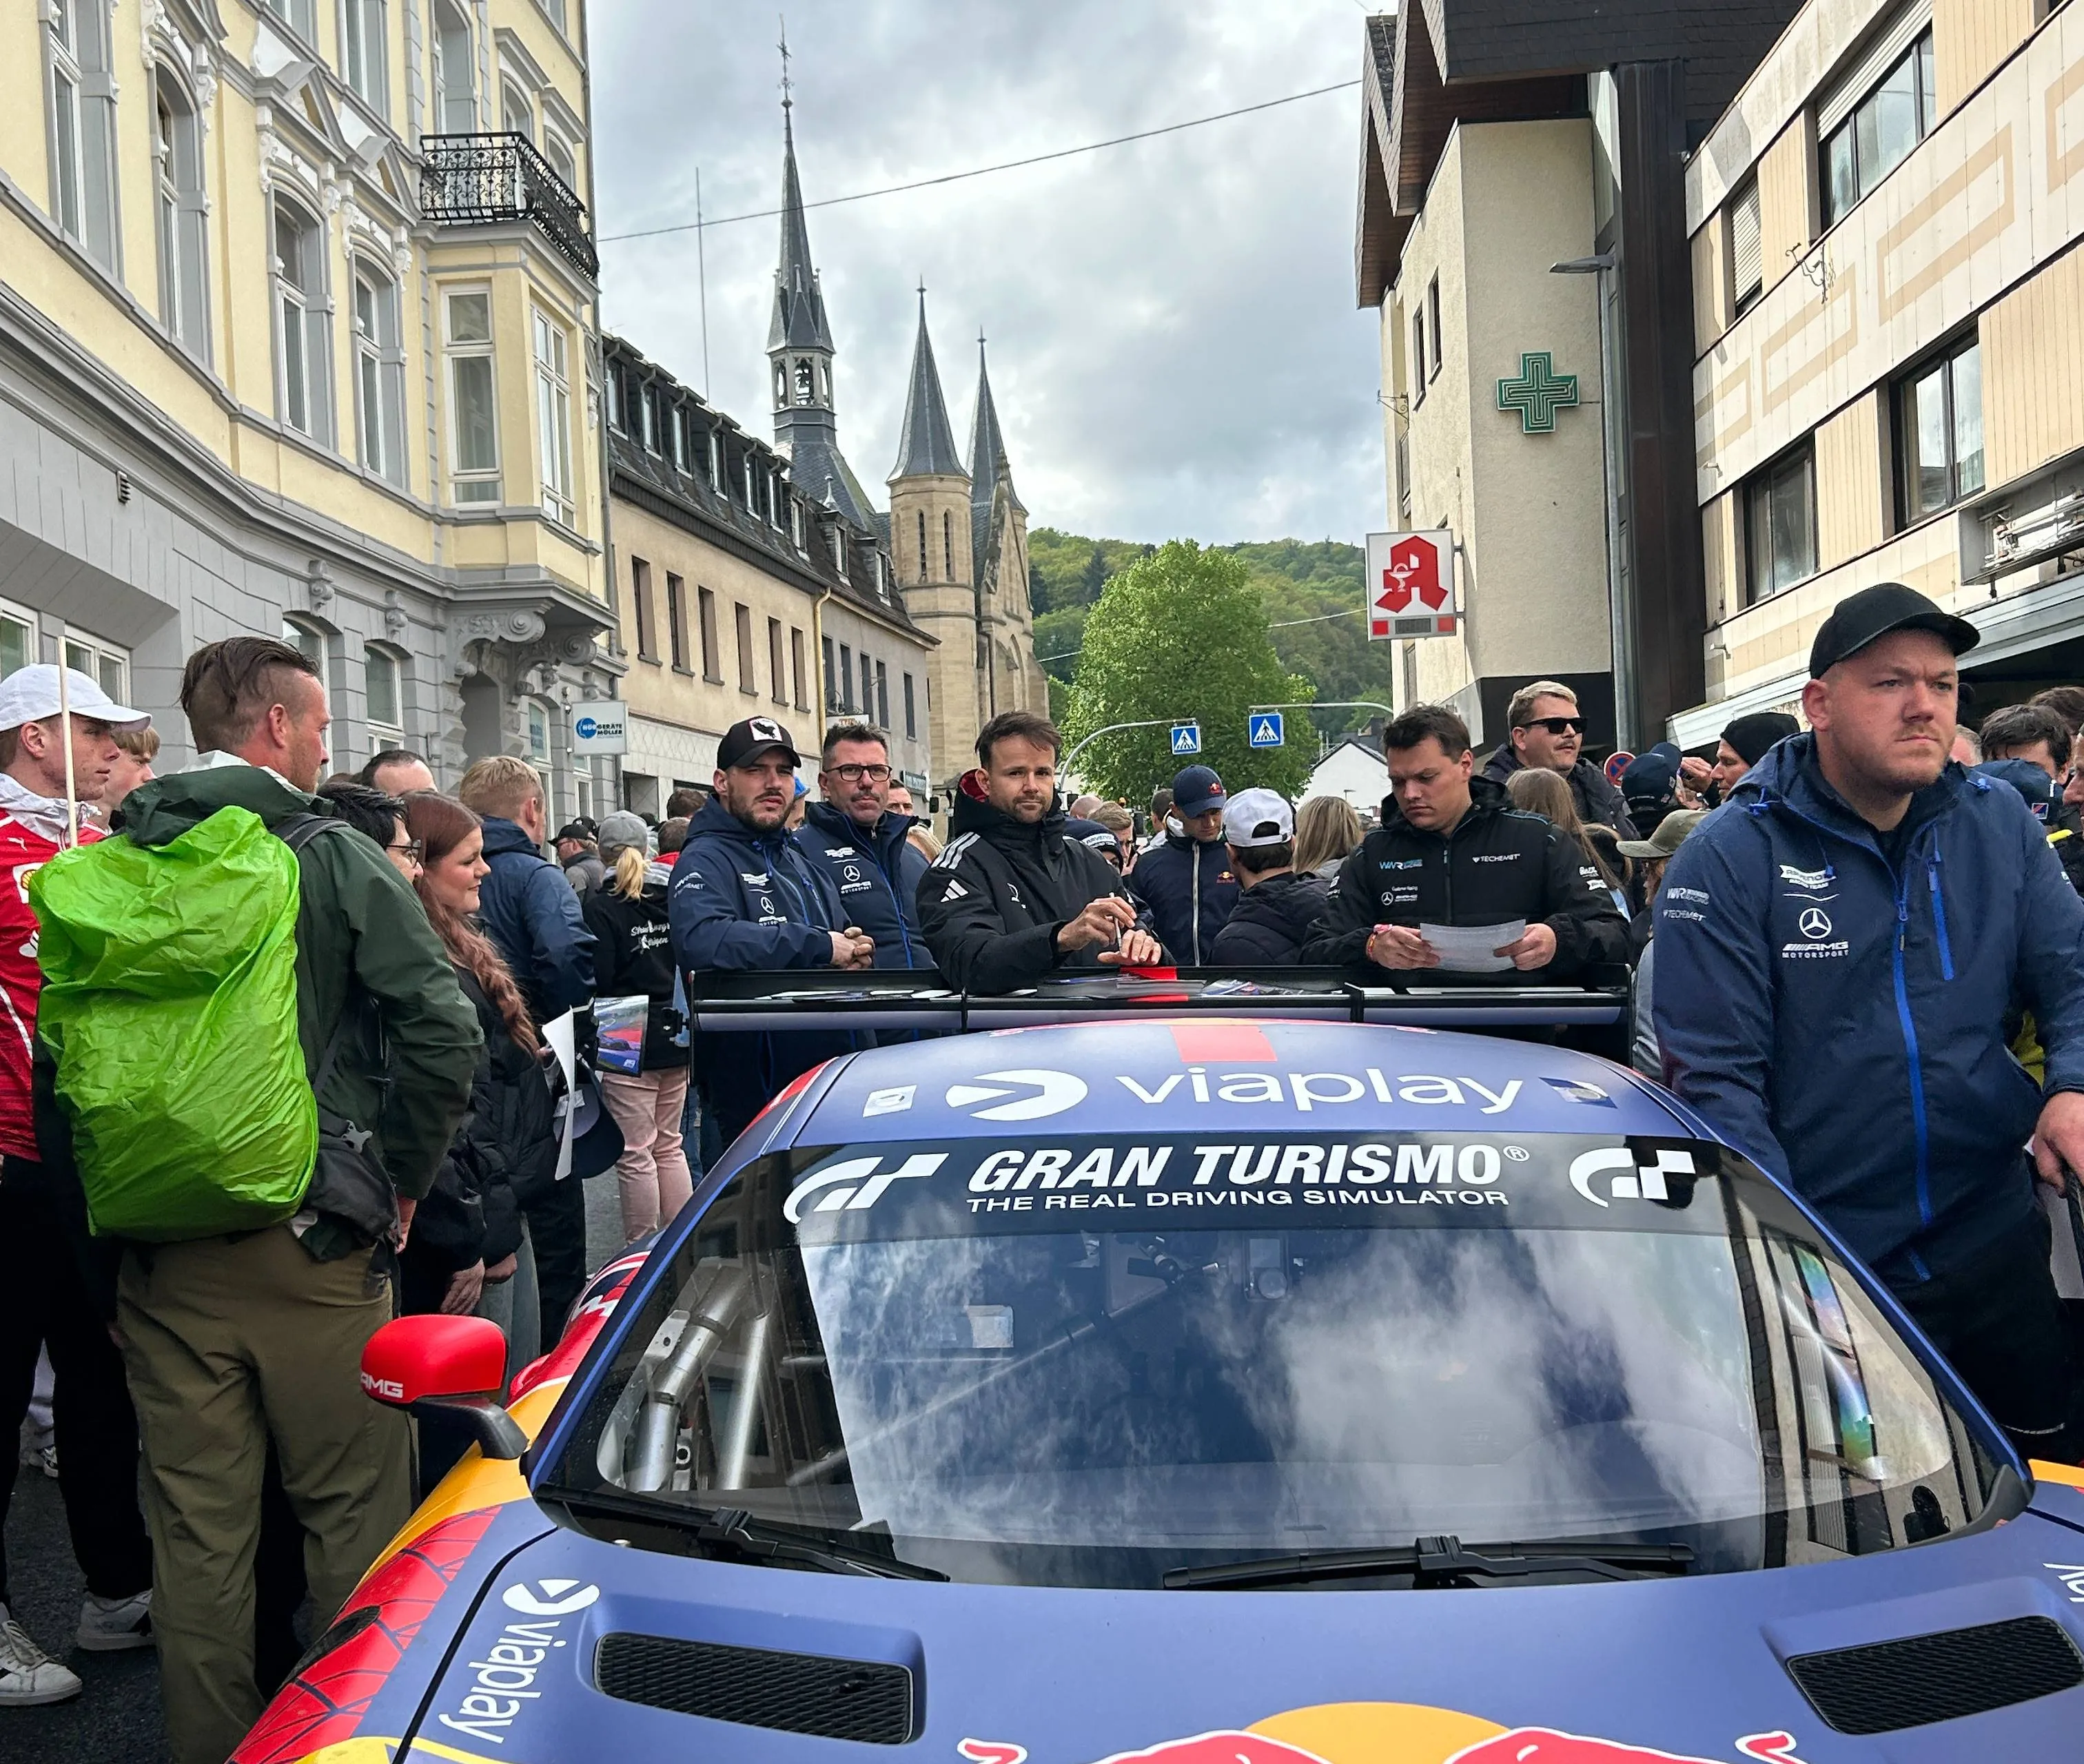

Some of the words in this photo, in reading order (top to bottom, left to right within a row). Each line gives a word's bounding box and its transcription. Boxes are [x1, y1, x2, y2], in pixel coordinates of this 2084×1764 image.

[1781, 949, 1848, 958] MOTORSPORT
[1805, 941, 1848, 951] AMG
[1114, 1067, 1524, 1114] viaplay
[967, 1147, 1173, 1193] GRAN
[966, 1196, 1034, 1214] THE
[1045, 1193, 1136, 1210] REAL
[1145, 1190, 1293, 1207] DRIVING
[1302, 1190, 1510, 1207] SIMULATOR
[360, 1371, 403, 1399] AMG
[438, 1620, 567, 1744] viaplay
